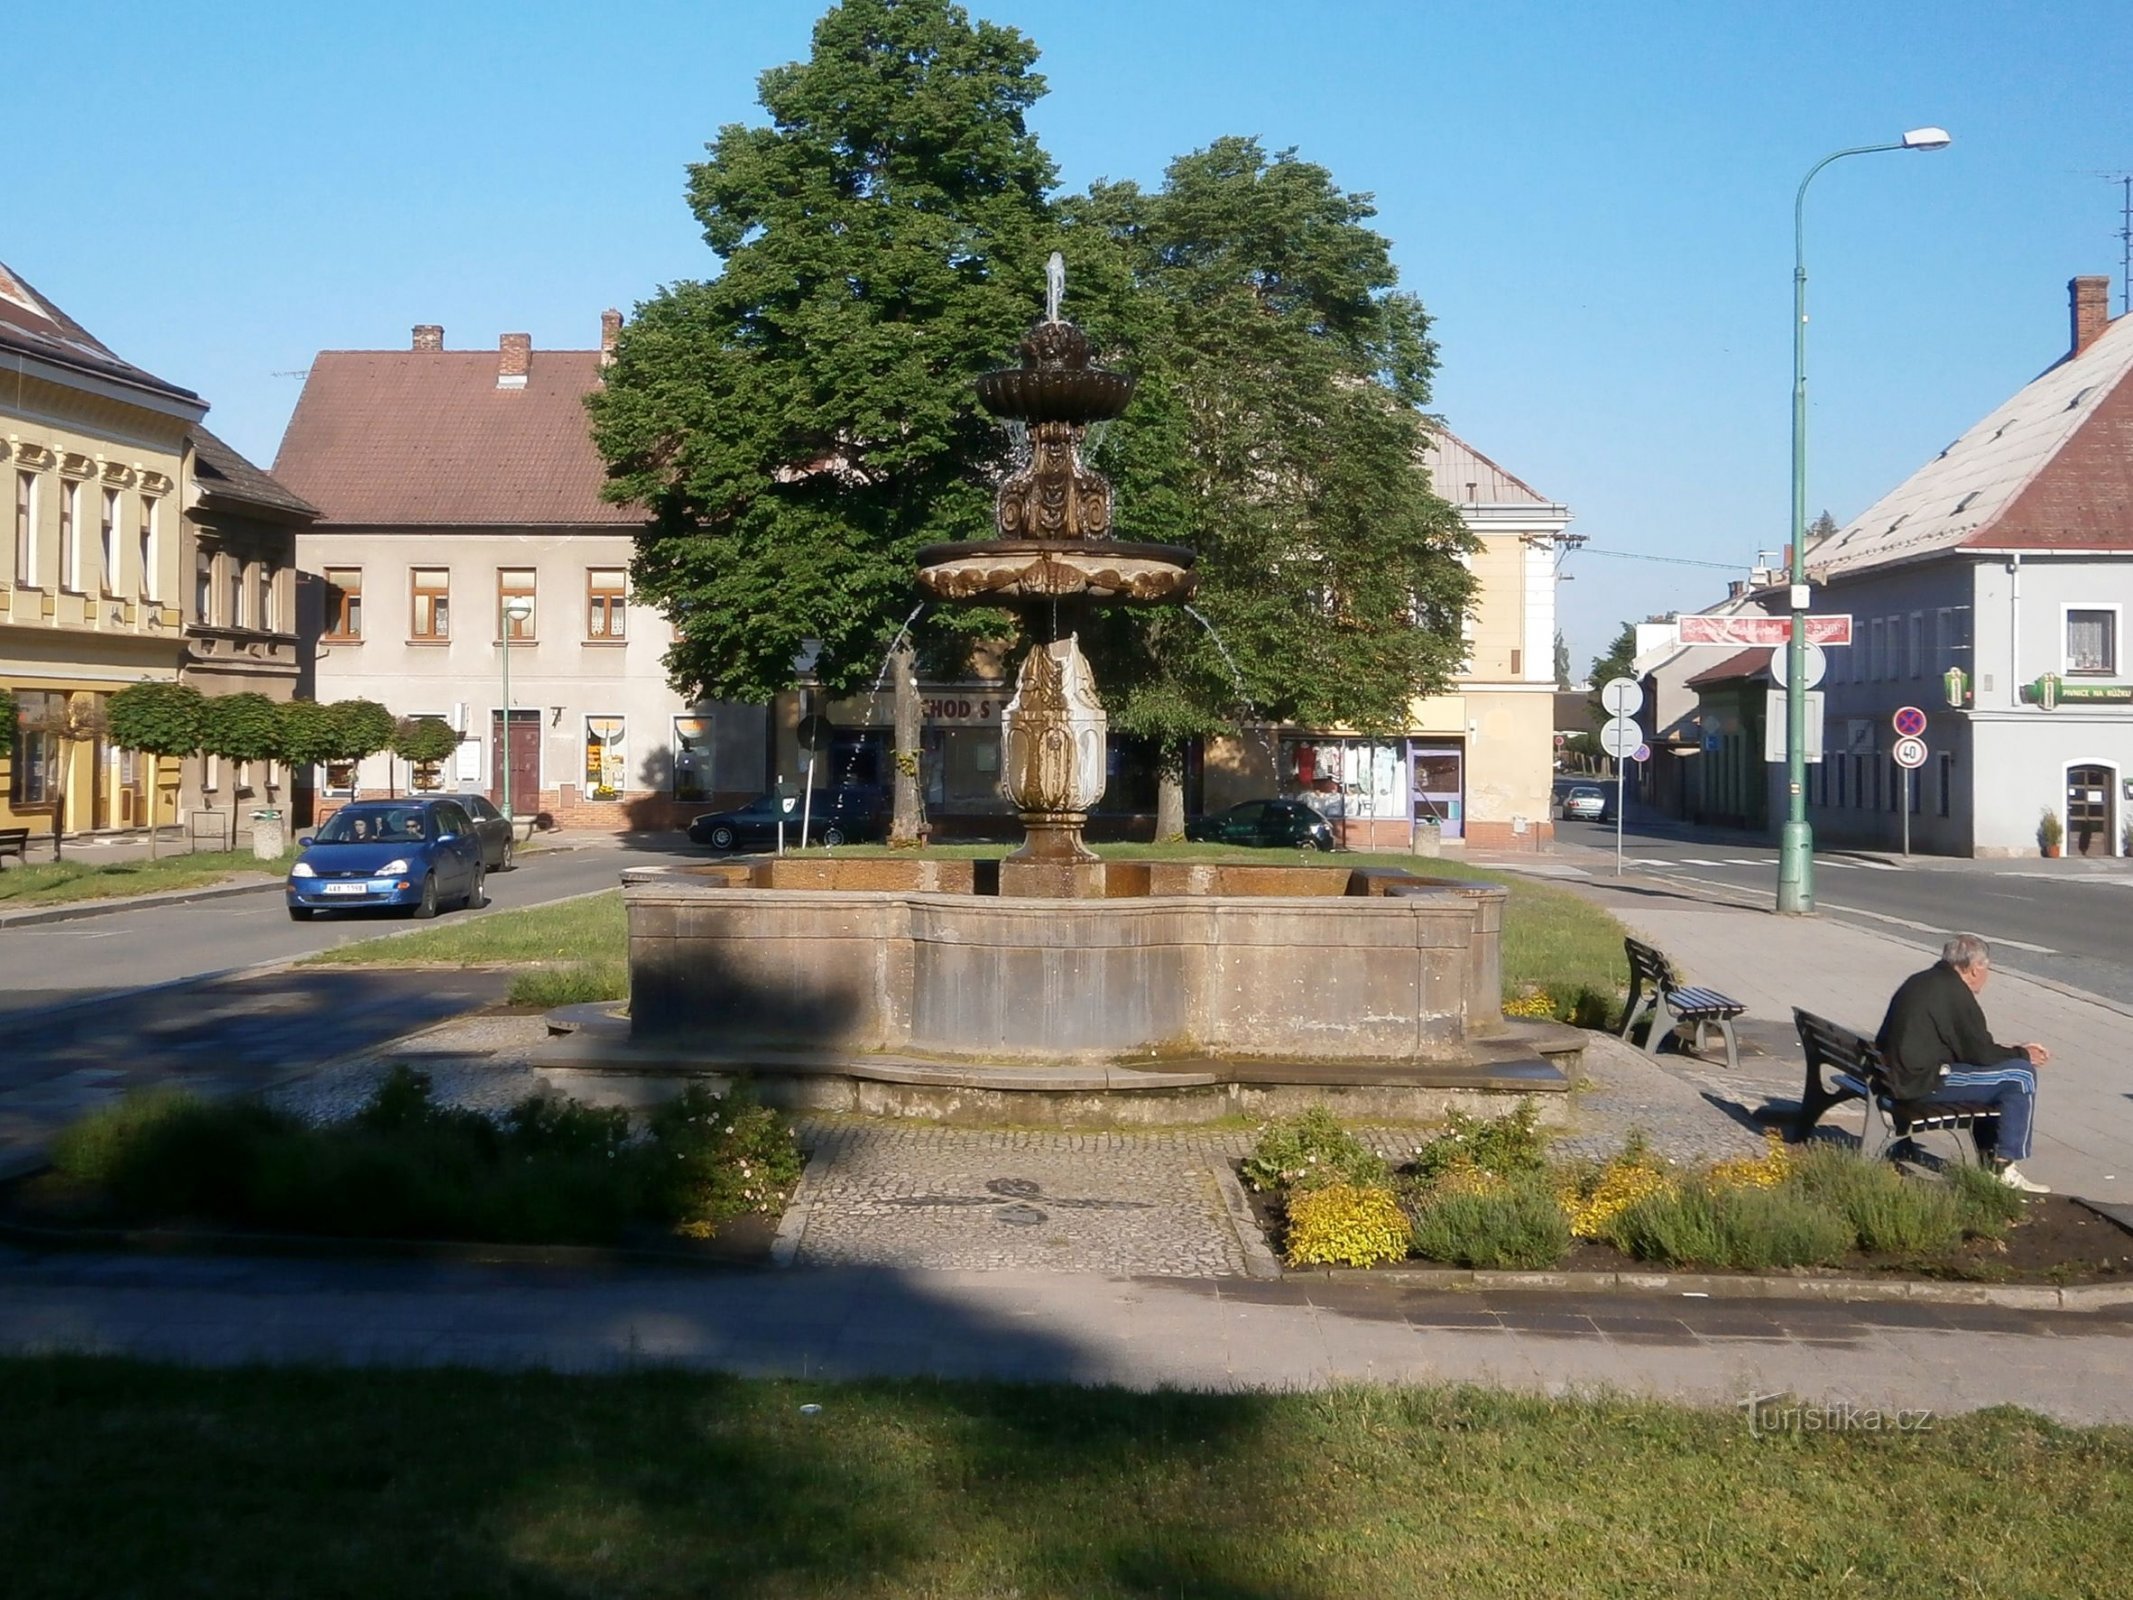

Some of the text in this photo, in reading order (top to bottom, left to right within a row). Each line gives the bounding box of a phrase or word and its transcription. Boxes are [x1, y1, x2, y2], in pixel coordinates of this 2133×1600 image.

[2062, 688, 2089, 697] PIVNICE
[2093, 688, 2104, 697] NA
[1903, 745, 1916, 759] 40
